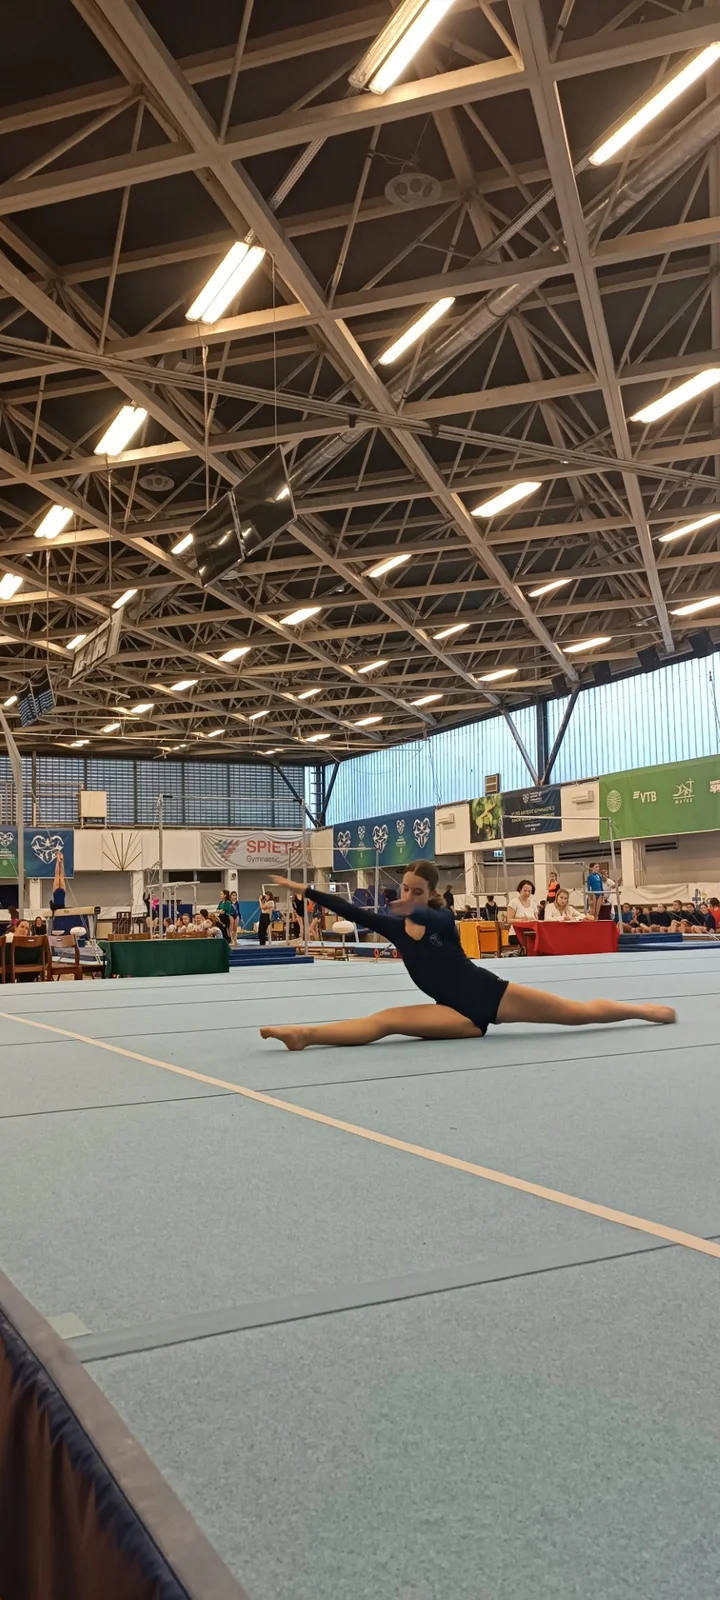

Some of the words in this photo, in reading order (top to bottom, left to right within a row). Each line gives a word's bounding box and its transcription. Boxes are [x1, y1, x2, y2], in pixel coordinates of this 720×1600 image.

[640, 791, 657, 803] VTB
[246, 840, 302, 854] SPIETH
[247, 855, 280, 863] Gymnastic
